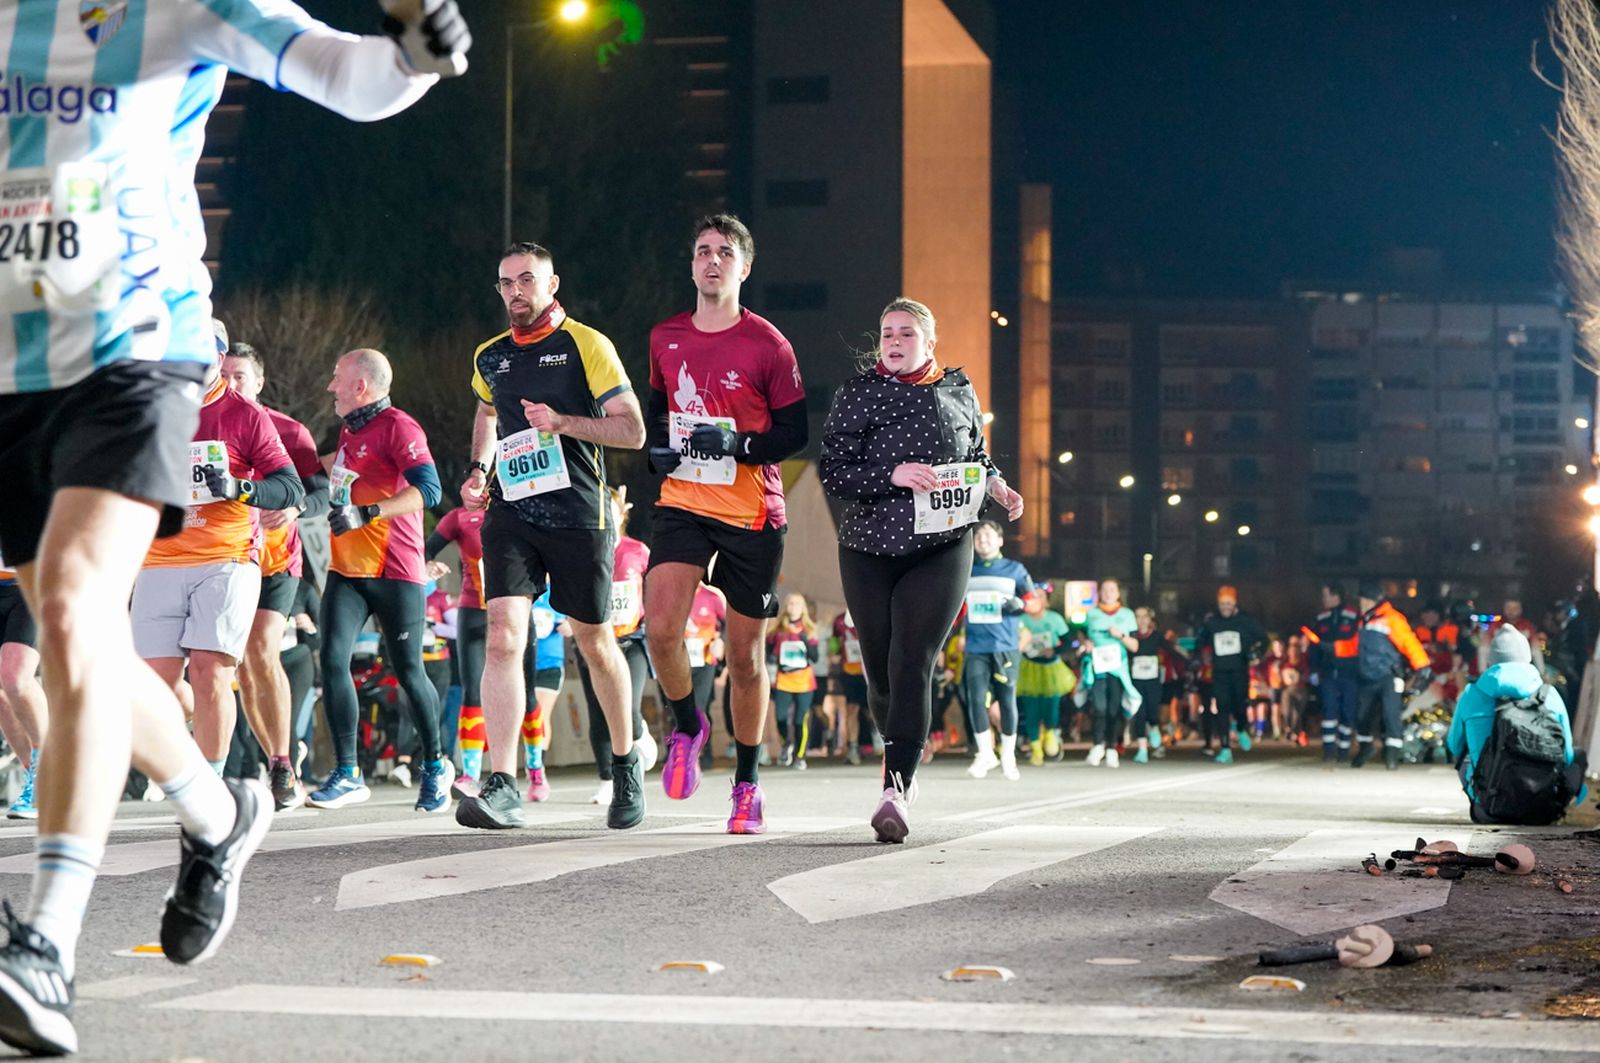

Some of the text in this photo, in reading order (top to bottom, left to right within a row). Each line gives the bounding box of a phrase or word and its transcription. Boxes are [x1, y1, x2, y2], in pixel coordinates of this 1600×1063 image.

[0, 220, 79, 262] 2478
[540, 353, 568, 363] FOCUS
[508, 449, 550, 478] 9610
[930, 486, 972, 511] 6991
